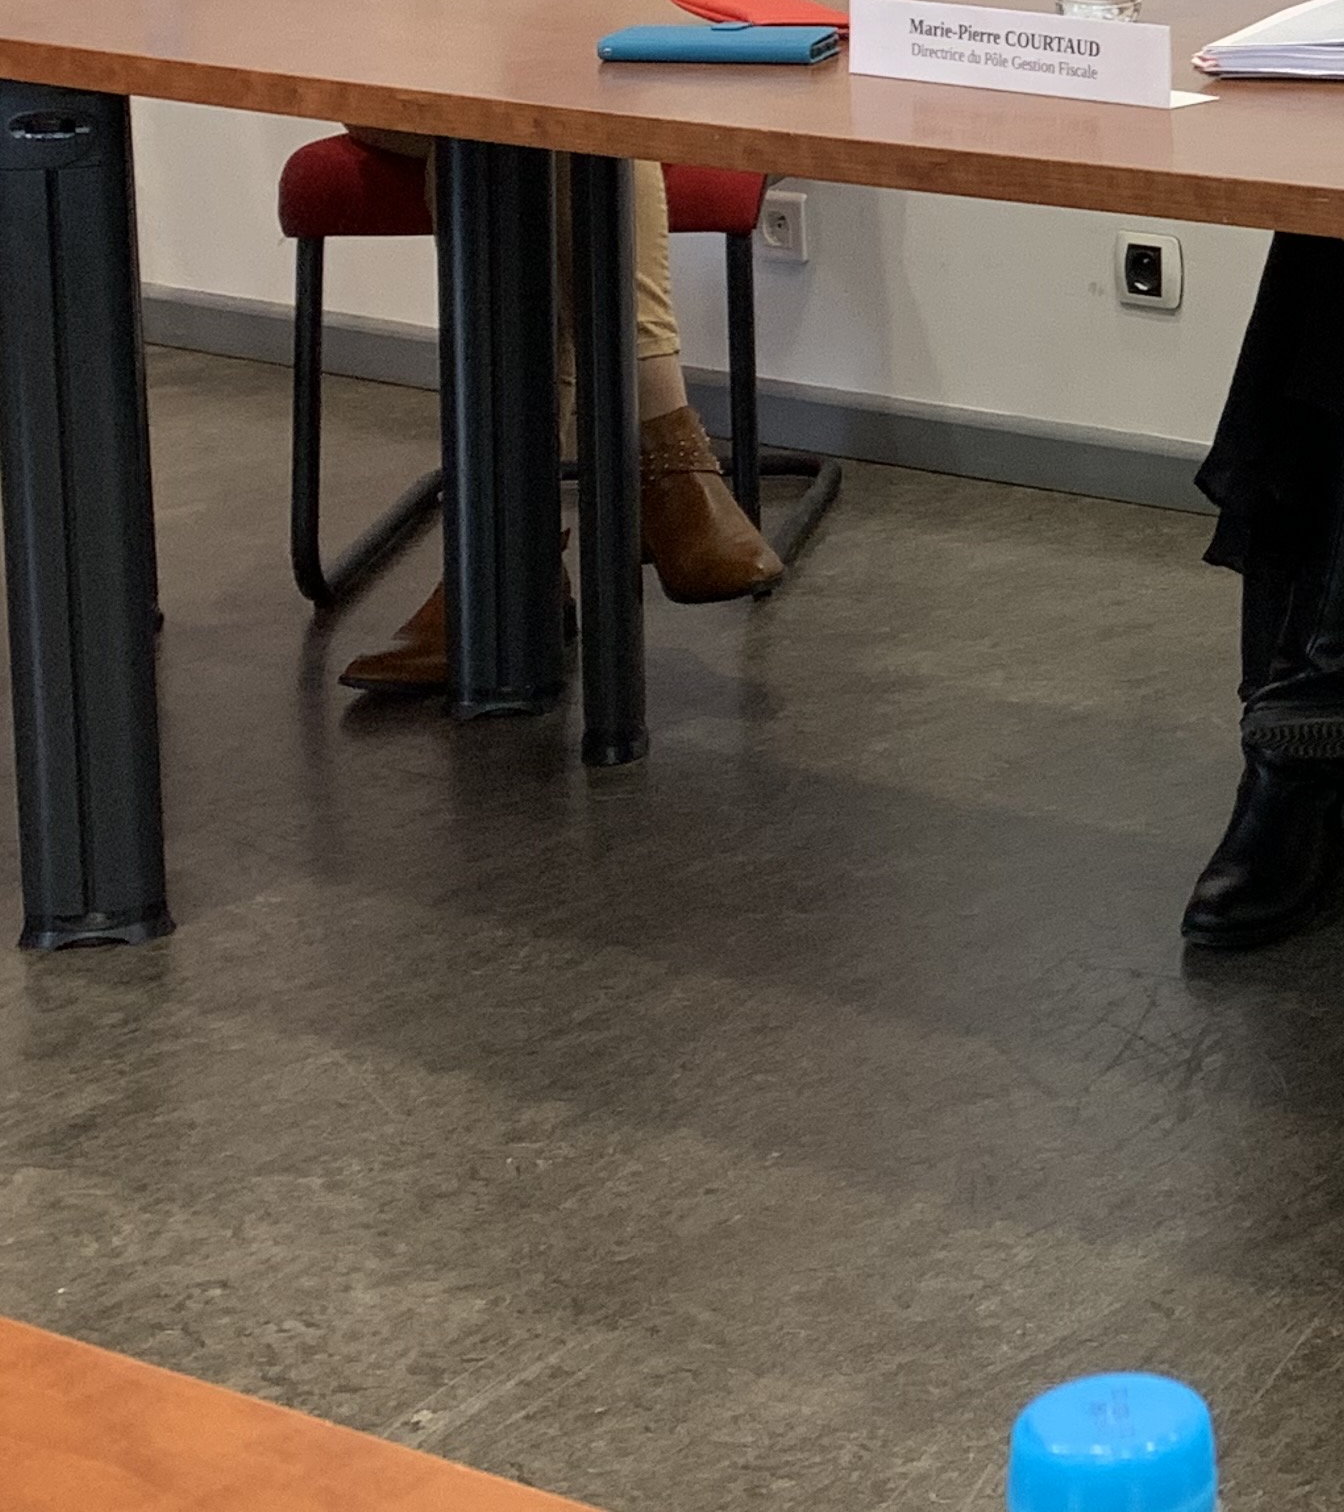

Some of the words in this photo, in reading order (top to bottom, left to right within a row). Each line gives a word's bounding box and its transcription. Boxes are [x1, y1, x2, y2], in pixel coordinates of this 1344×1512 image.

[909, 17, 1001, 46] Marie-Pierre
[1004, 30, 1101, 57] COURTAUD
[911, 42, 965, 63] Directrice
[967, 50, 982, 65] du
[984, 51, 1009, 69] Pôle
[1011, 55, 1056, 75] Gestion
[1058, 61, 1098, 80] Fiscale
